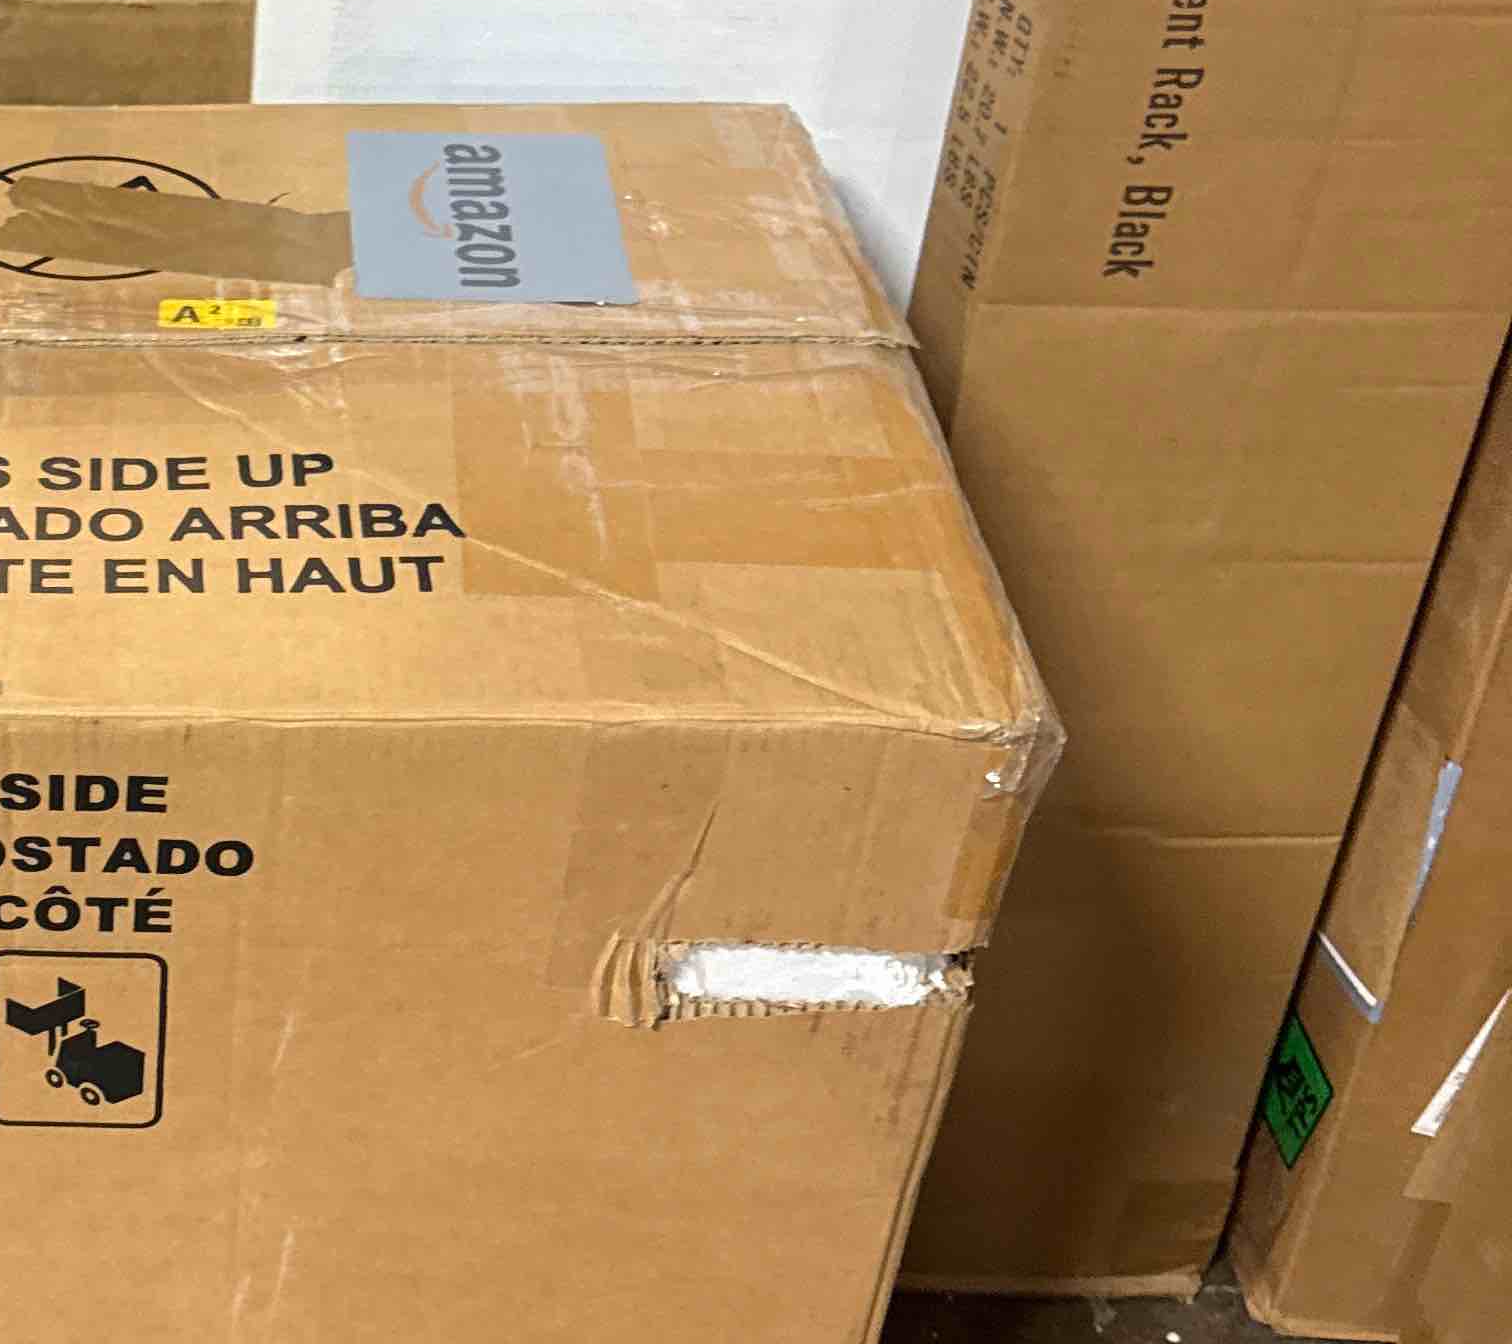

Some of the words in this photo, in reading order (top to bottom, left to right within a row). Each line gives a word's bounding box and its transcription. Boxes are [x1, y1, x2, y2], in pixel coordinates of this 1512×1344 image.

[1126, 68, 1205, 165] Rack,
[442, 142, 521, 290] amazon
[1102, 186, 1174, 279] Black
[171, 305, 201, 324] A
[37, 455, 210, 492] SIDE
[236, 453, 335, 488] UP
[170, 502, 467, 542] ARRIBA
[104, 557, 205, 594] EN
[236, 555, 445, 594] HAUT
